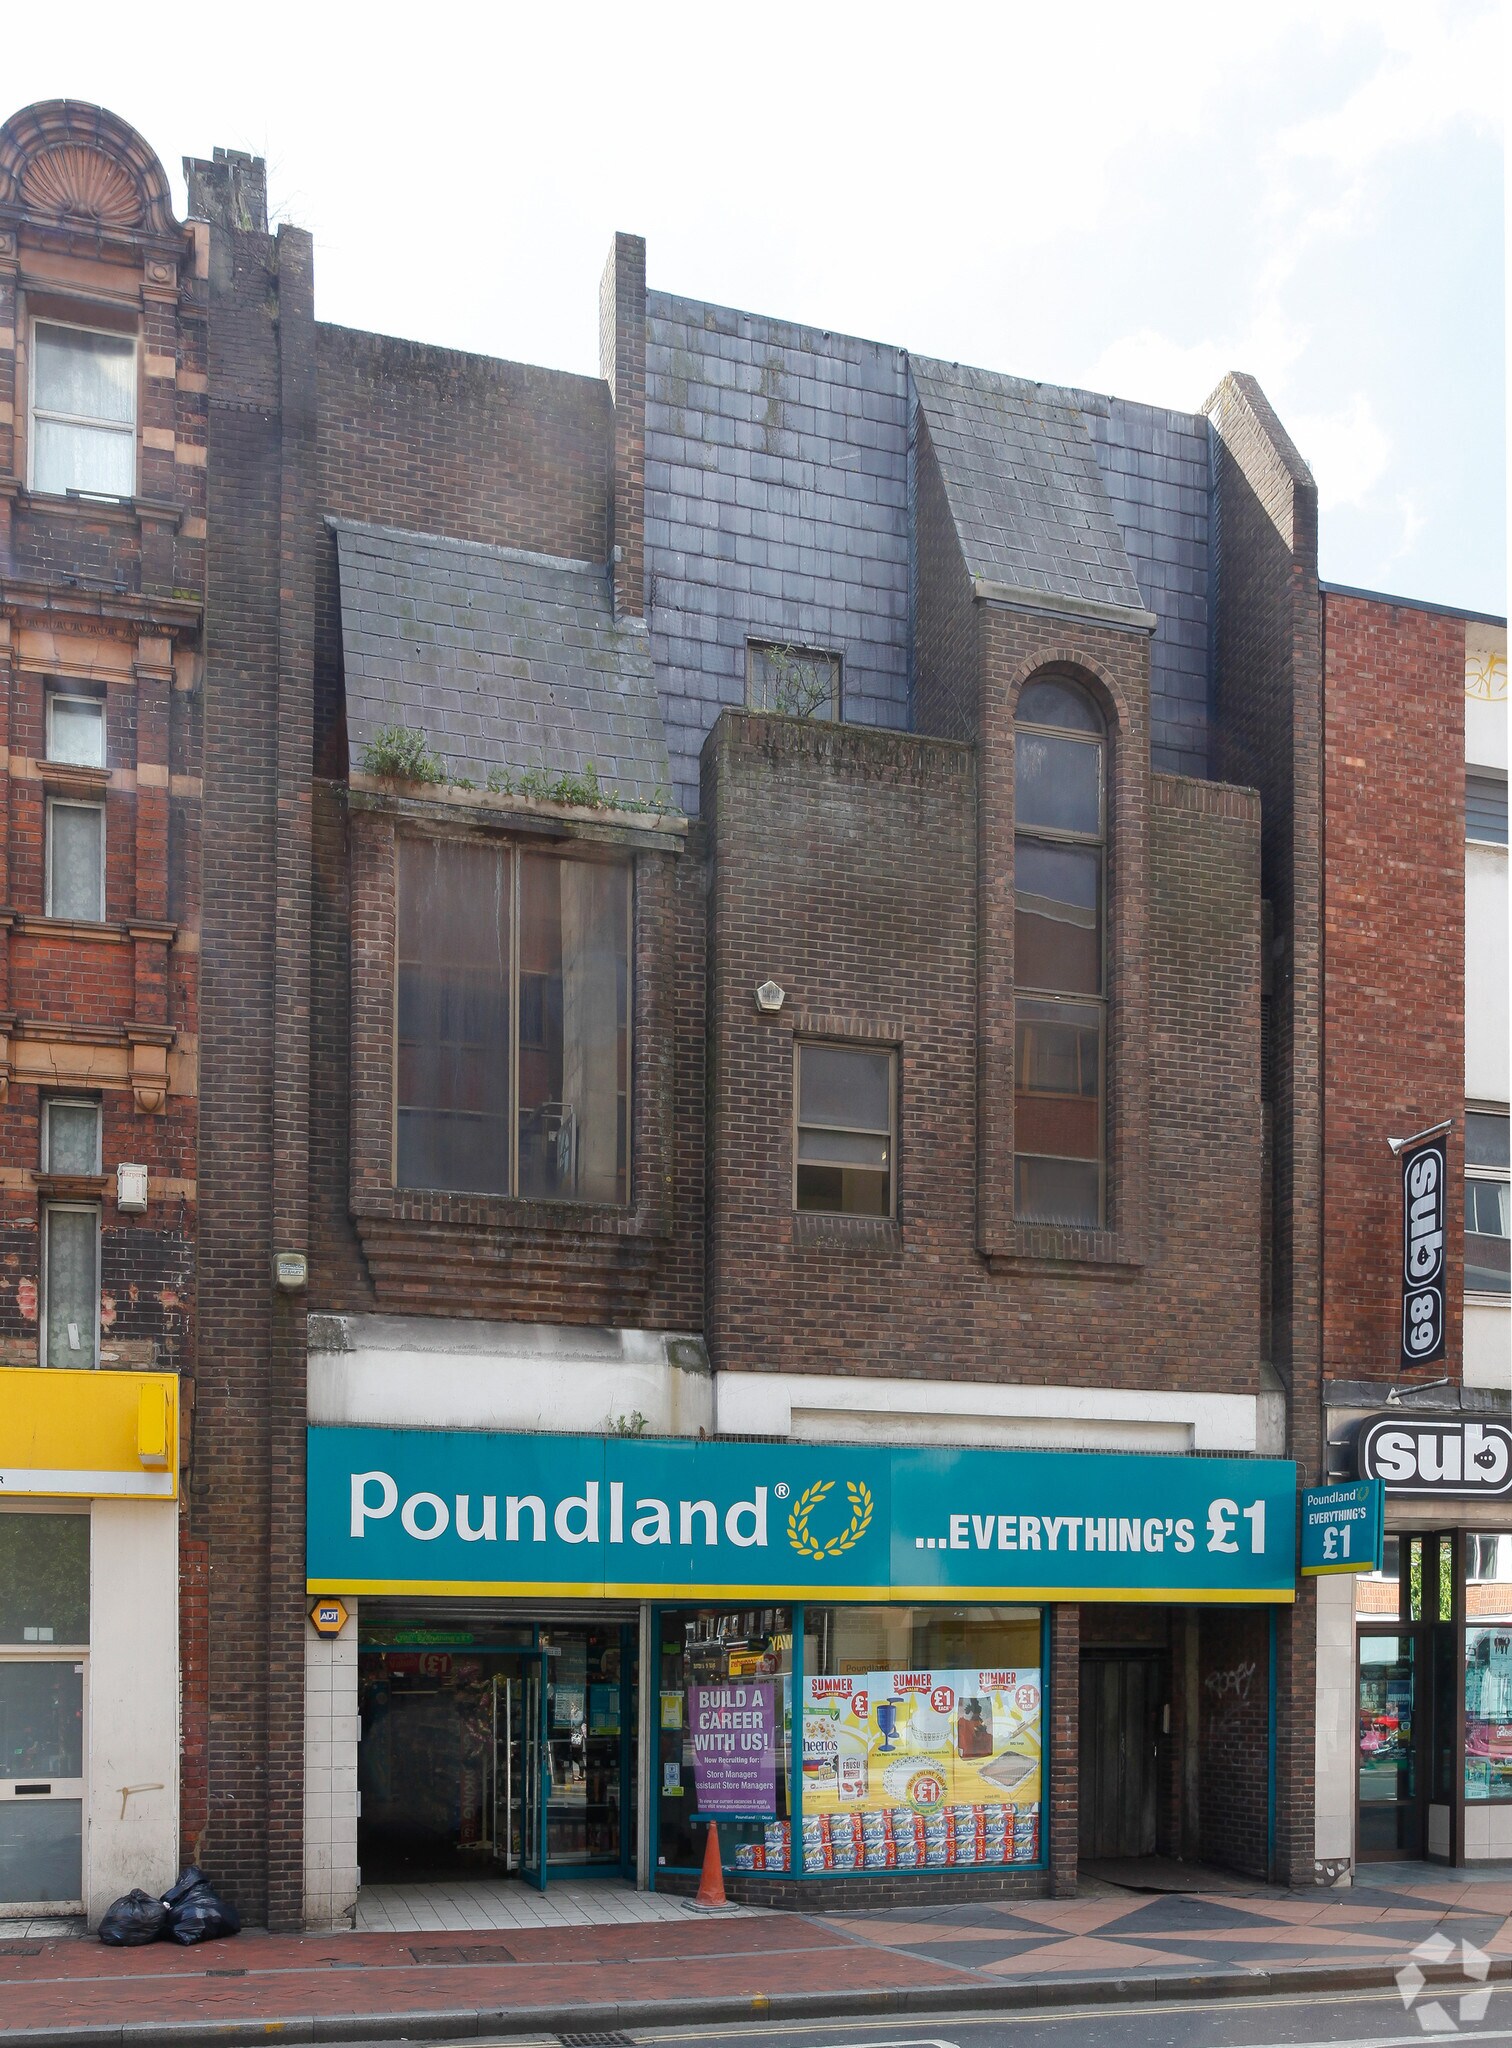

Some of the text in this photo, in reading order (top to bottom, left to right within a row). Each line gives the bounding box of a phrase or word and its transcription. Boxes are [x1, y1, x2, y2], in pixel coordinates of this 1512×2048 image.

[1410, 1158, 1442, 1277] sub
[1410, 1294, 1434, 1350] 89
[1375, 1423, 1508, 1483] sub
[1307, 1488, 1356, 1507] Poundland
[1308, 1507, 1367, 1525] EVERYTHING'S
[1206, 1498, 1265, 1554] £1
[1322, 1524, 1351, 1559] £1
[320, 1611, 339, 1621] ADT
[428, 1655, 448, 1673] £1
[811, 1678, 853, 1691] SUMMER
[893, 1673, 932, 1686] SUMMER
[979, 1672, 1016, 1684] SUMMER
[699, 1689, 764, 1708] BUILD A
[933, 1690, 951, 1706] £1
[1018, 1688, 1035, 1704] £1
[700, 1711, 764, 1730] CAREER
[694, 1733, 768, 1751] WITH US!
[803, 1739, 838, 1752] heerios
[704, 1756, 760, 1765] Now Recruiting for:
[706, 1770, 758, 1779] Store Managers
[722, 1781, 740, 1789] Store
[741, 1781, 774, 1791] Managers
[917, 1782, 936, 1802] £1
